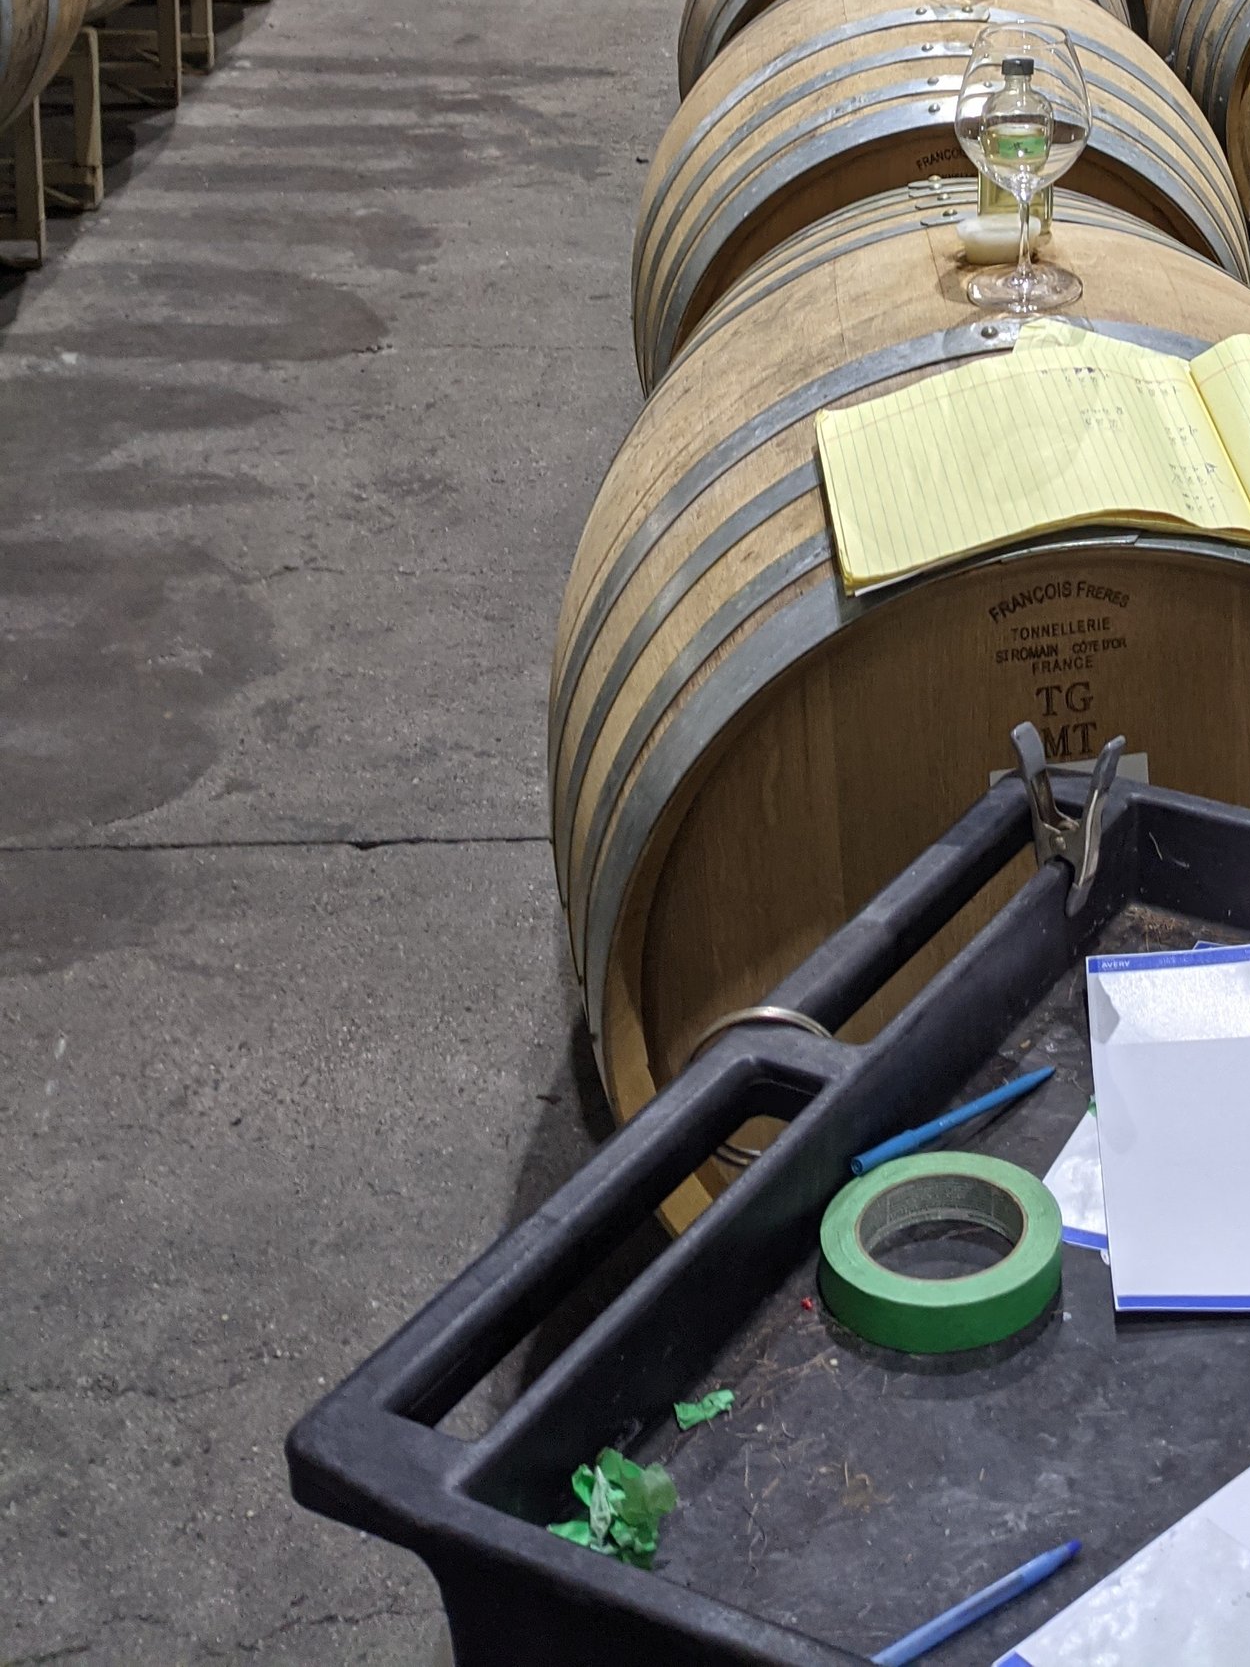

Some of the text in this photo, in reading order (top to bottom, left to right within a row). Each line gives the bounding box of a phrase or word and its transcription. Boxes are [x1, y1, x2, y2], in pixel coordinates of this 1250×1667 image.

[1010, 616, 1111, 641] TONNELLERIE
[1032, 655, 1094, 675] FRANCE
[1035, 681, 1095, 716] TG
[1042, 721, 1098, 759] MT
[1101, 960, 1130, 969] AVERY
